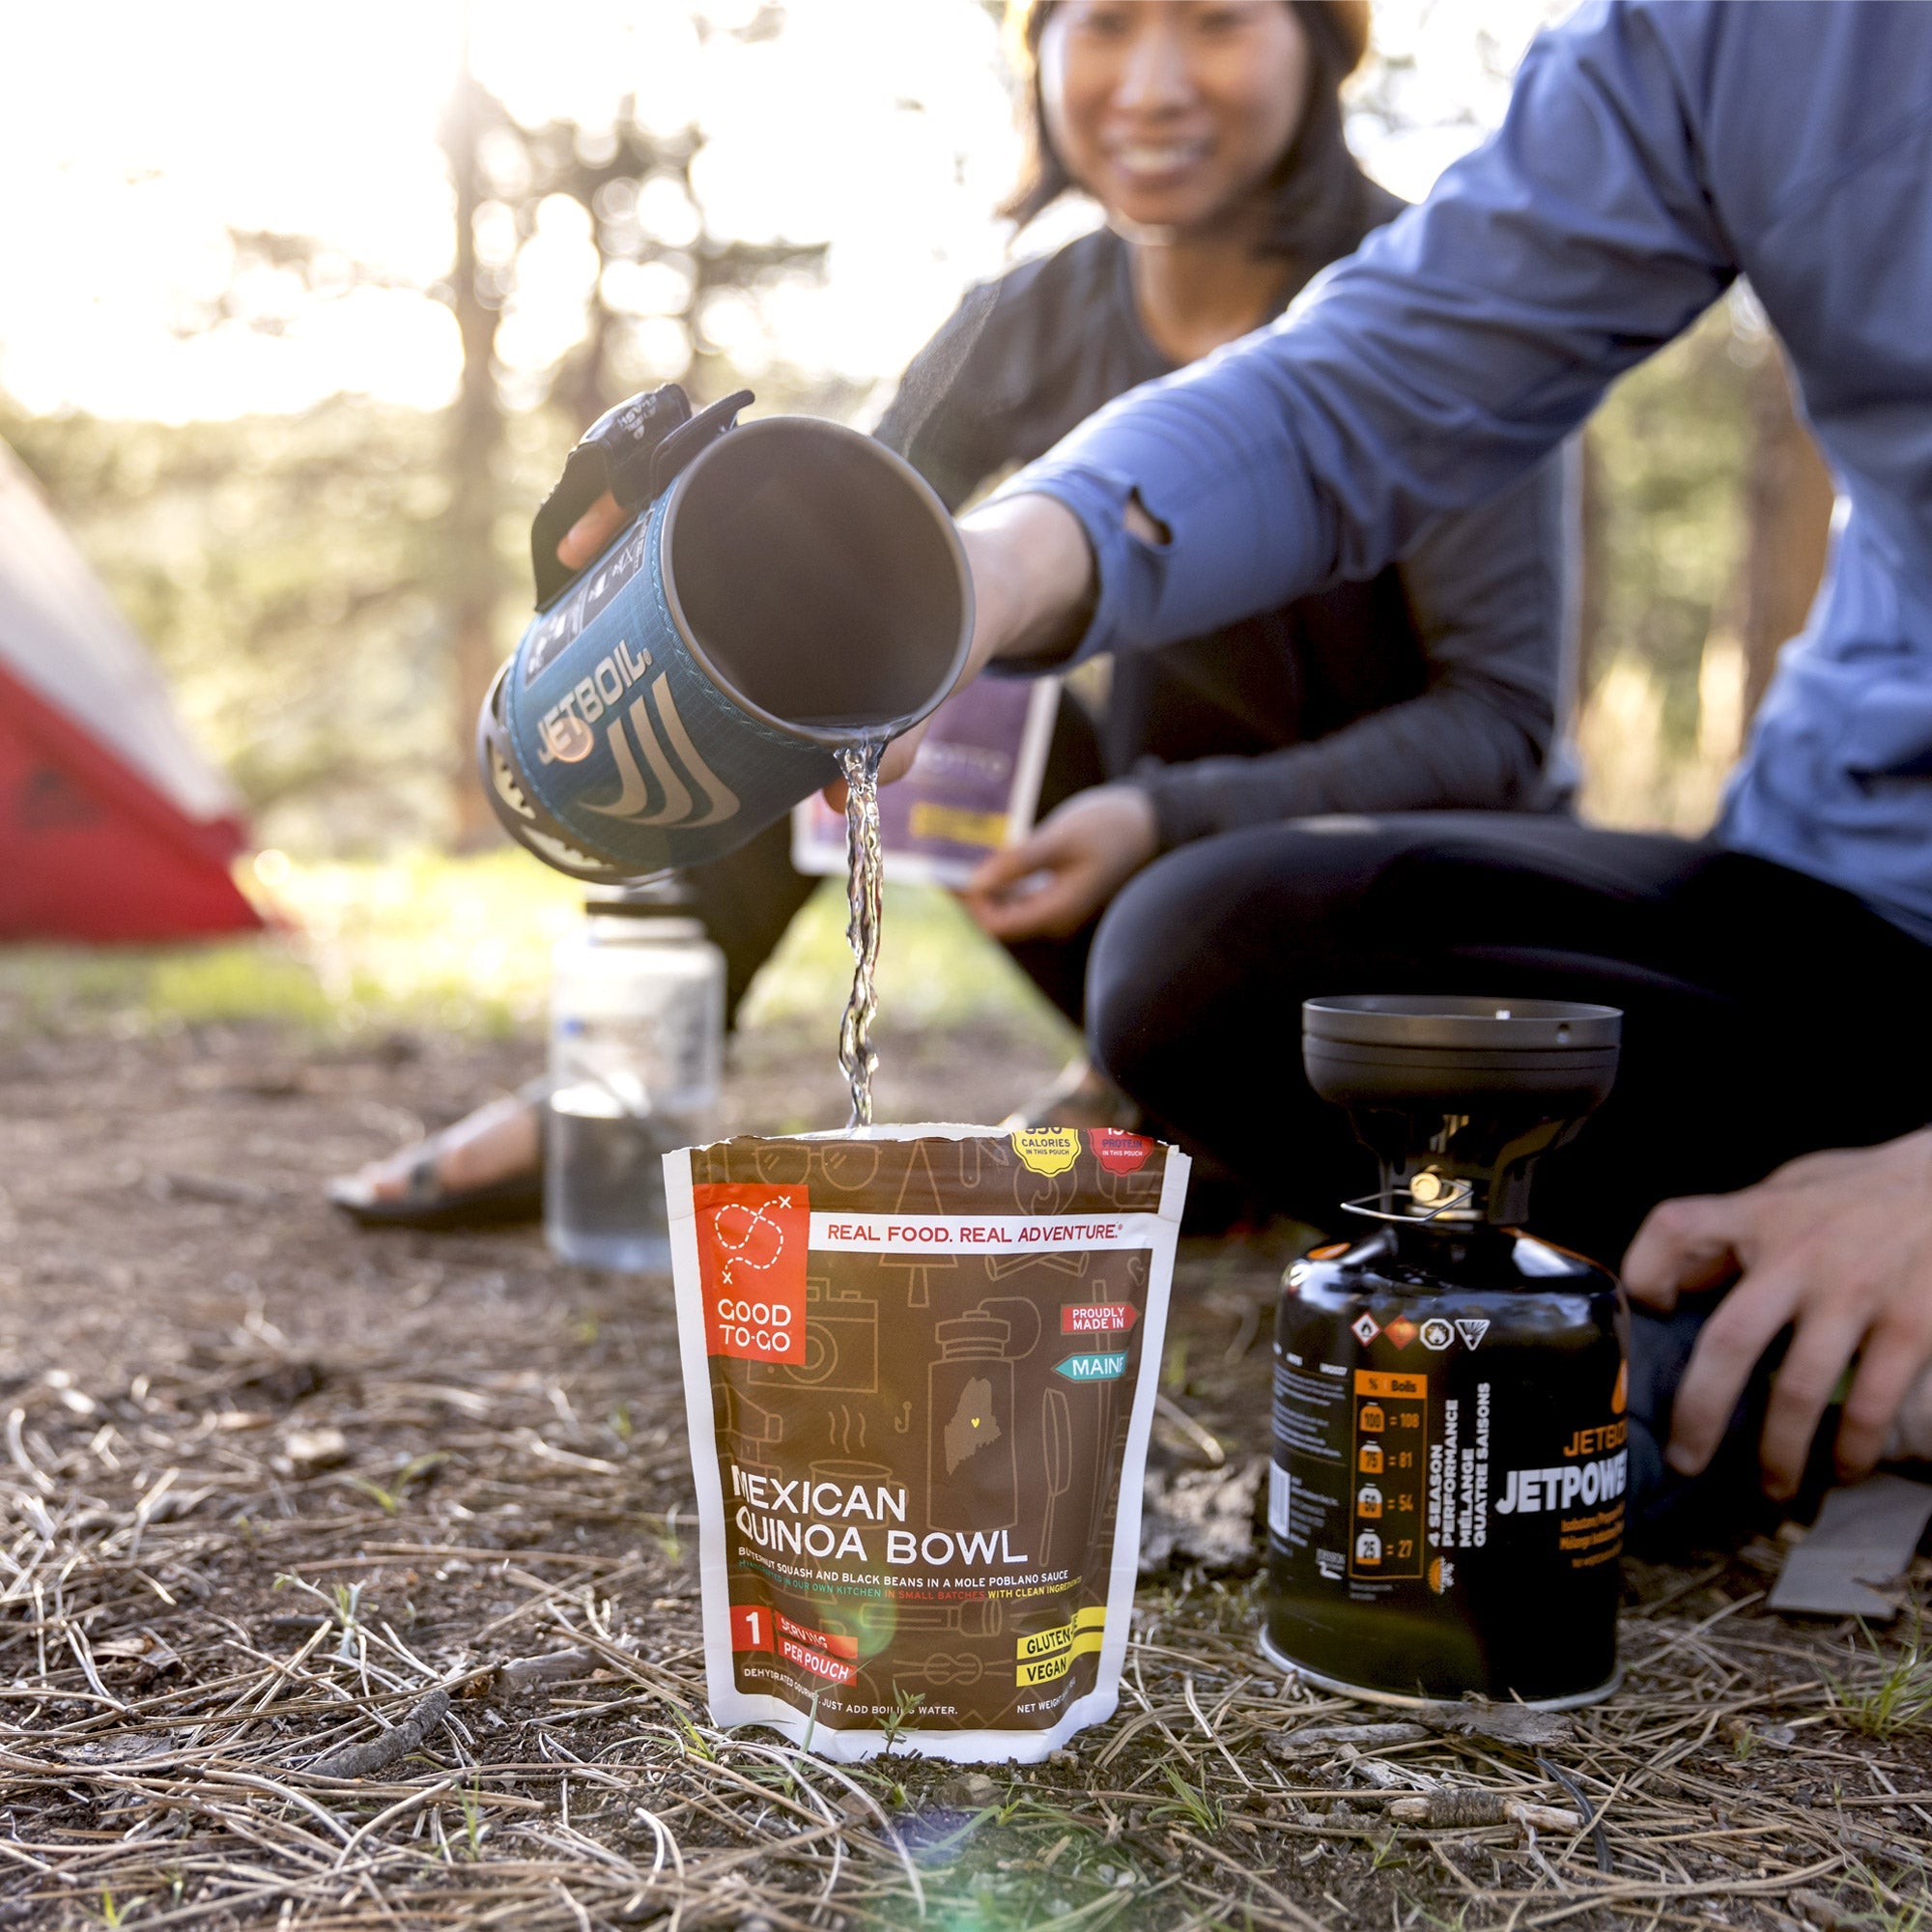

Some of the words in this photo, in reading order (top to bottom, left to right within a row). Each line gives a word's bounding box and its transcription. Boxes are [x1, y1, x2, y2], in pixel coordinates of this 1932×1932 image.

[537, 639, 648, 765] JETBOIL
[1021, 1138, 1070, 1148] CALORIES
[1102, 1138, 1143, 1149] PROTEIN
[828, 1224, 880, 1241] REAL
[887, 1226, 953, 1243] FOOD.
[959, 1227, 1012, 1243] REAL
[718, 1298, 791, 1326] GOOD
[1072, 1307, 1124, 1319] PROUDLY
[1073, 1319, 1109, 1330] MADE
[1112, 1318, 1124, 1328] IN
[719, 1323, 791, 1352] TO-GO
[1475, 1382, 1491, 1461] SAISONS
[1429, 1444, 1443, 1528] SEASON
[1441, 1399, 1459, 1548] PERFORMANCE
[731, 1464, 906, 1522] MEXICAN
[1398, 1493, 1413, 1512] 54
[1458, 1448, 1474, 1548] MÉLANGE
[1473, 1463, 1489, 1548] QUATRE
[735, 1505, 868, 1561] QUINOA
[886, 1529, 1029, 1566] BOWL
[1363, 1541, 1375, 1558] 25
[1397, 1539, 1413, 1558] 27
[1428, 1531, 1440, 1548] 4
[738, 1547, 775, 1569] BUTERNUT
[777, 1562, 813, 1578] SQUASH
[815, 1570, 838, 1581] AND
[842, 1573, 881, 1584] BLACK
[884, 1576, 923, 1588] BEANS
[927, 1577, 939, 1588] IN
[943, 1577, 952, 1588] A
[954, 1577, 985, 1588] MOLE
[989, 1576, 1038, 1587] POBLANO
[1041, 1570, 1068, 1584] SAUCE
[783, 1577, 791, 1586] IN
[793, 1579, 810, 1591] OUR
[812, 1583, 834, 1594] OWN
[837, 1586, 882, 1598] KITCHEN
[884, 1589, 895, 1599] IN
[898, 1589, 934, 1600] SMALL
[937, 1590, 985, 1600] BATCHES
[987, 1588, 1013, 1599] WITH
[1015, 1586, 1044, 1598] CLEAN
[746, 1611, 760, 1645] 1
[783, 1641, 803, 1663] PER
[805, 1653, 849, 1680] POUCH
[1026, 1656, 1067, 1682] VEGAN
[821, 1698, 843, 1711] JUST
[845, 1704, 868, 1715] ADD
[918, 1706, 958, 1715] WATER.
[1017, 1703, 1036, 1714] NET
